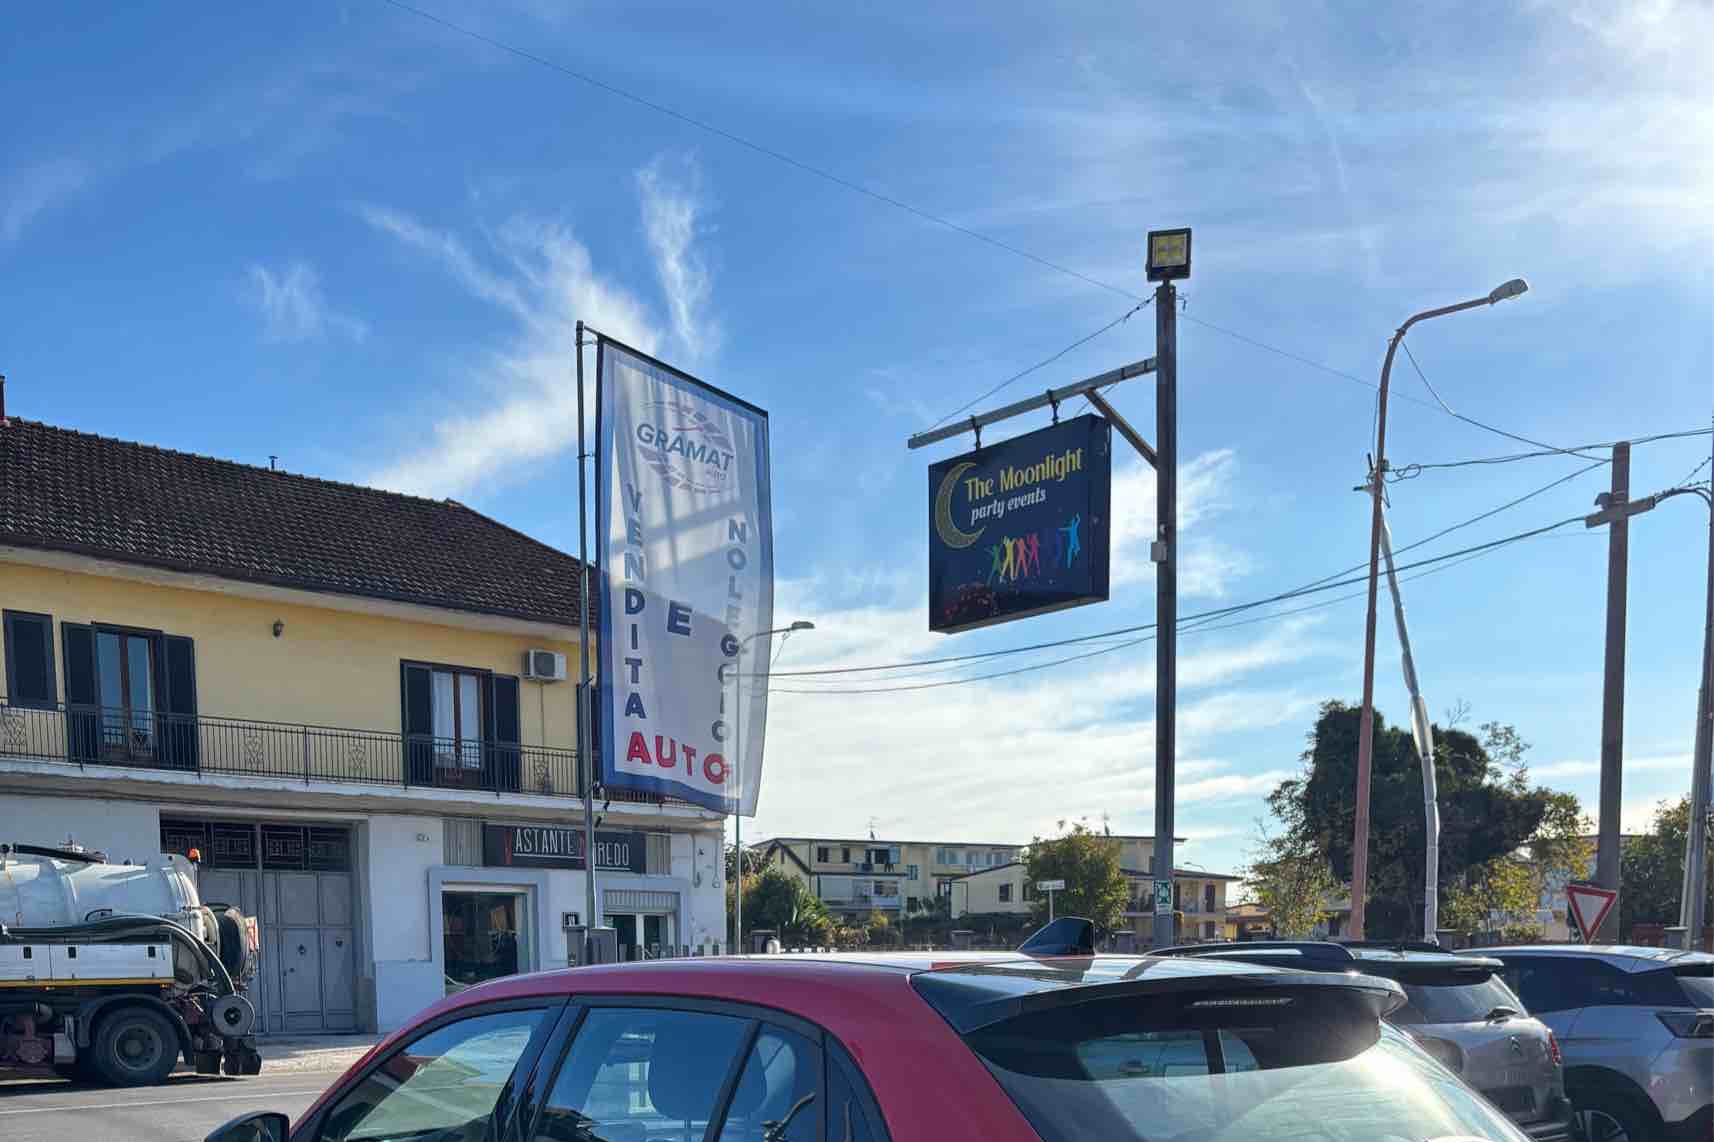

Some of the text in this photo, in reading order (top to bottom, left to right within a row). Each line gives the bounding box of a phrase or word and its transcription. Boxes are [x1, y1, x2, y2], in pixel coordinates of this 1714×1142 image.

[636, 423, 735, 472] GRAMAT
[964, 447, 1084, 503] The Moonlight
[970, 486, 1047, 527] party events
[624, 483, 647, 720] VENDITA
[666, 599, 693, 638] E
[626, 730, 733, 786] AUTO
